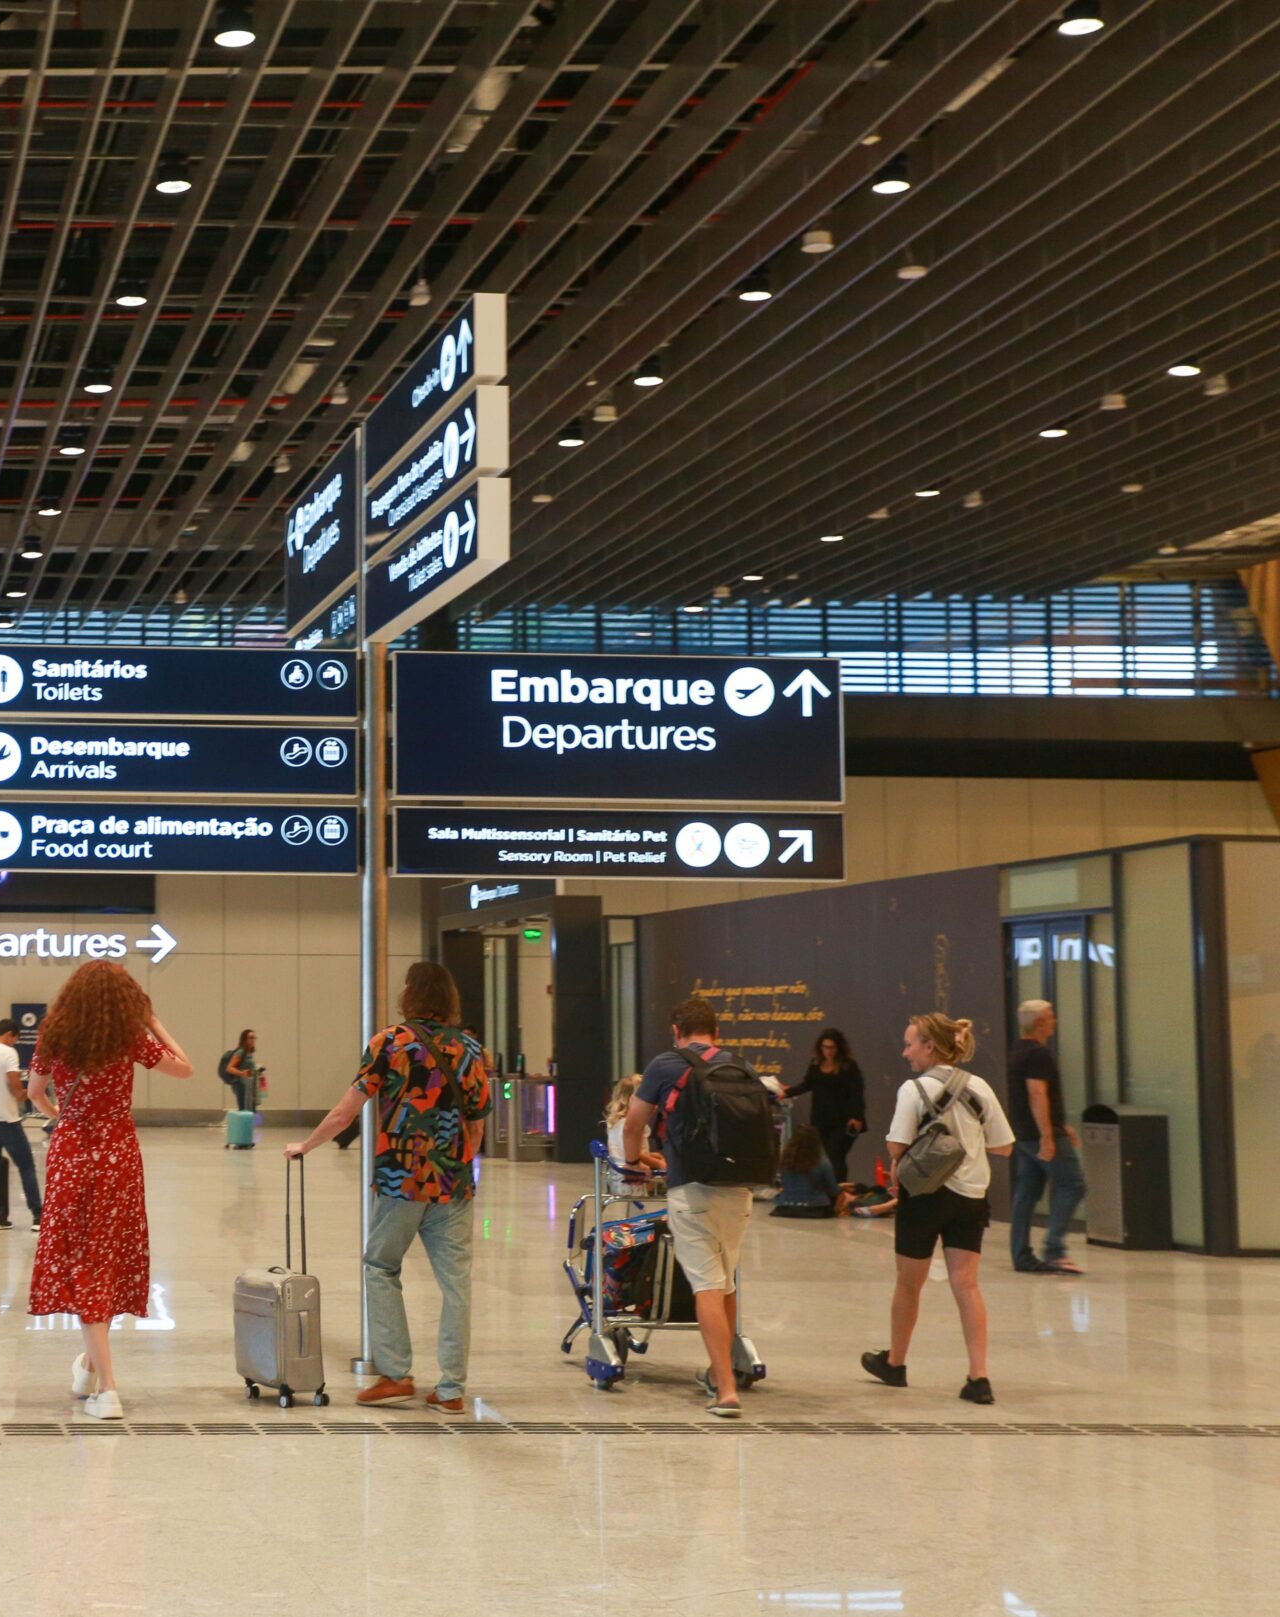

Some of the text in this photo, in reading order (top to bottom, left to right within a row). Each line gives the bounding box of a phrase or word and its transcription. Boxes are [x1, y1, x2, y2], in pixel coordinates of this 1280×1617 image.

[31, 659, 148, 680] Sanitários
[31, 682, 103, 702] Toilets
[491, 669, 716, 711] Embarque
[502, 715, 717, 755] Departures
[30, 736, 191, 760] Desembarque
[30, 760, 117, 780] Arrivals
[31, 815, 274, 840] Praça de alimentação
[427, 827, 668, 843] Sala Multissensorial Sanitário Pet
[31, 839, 154, 859] Food court
[498, 849, 667, 866] Sensory Room Pet Relief
